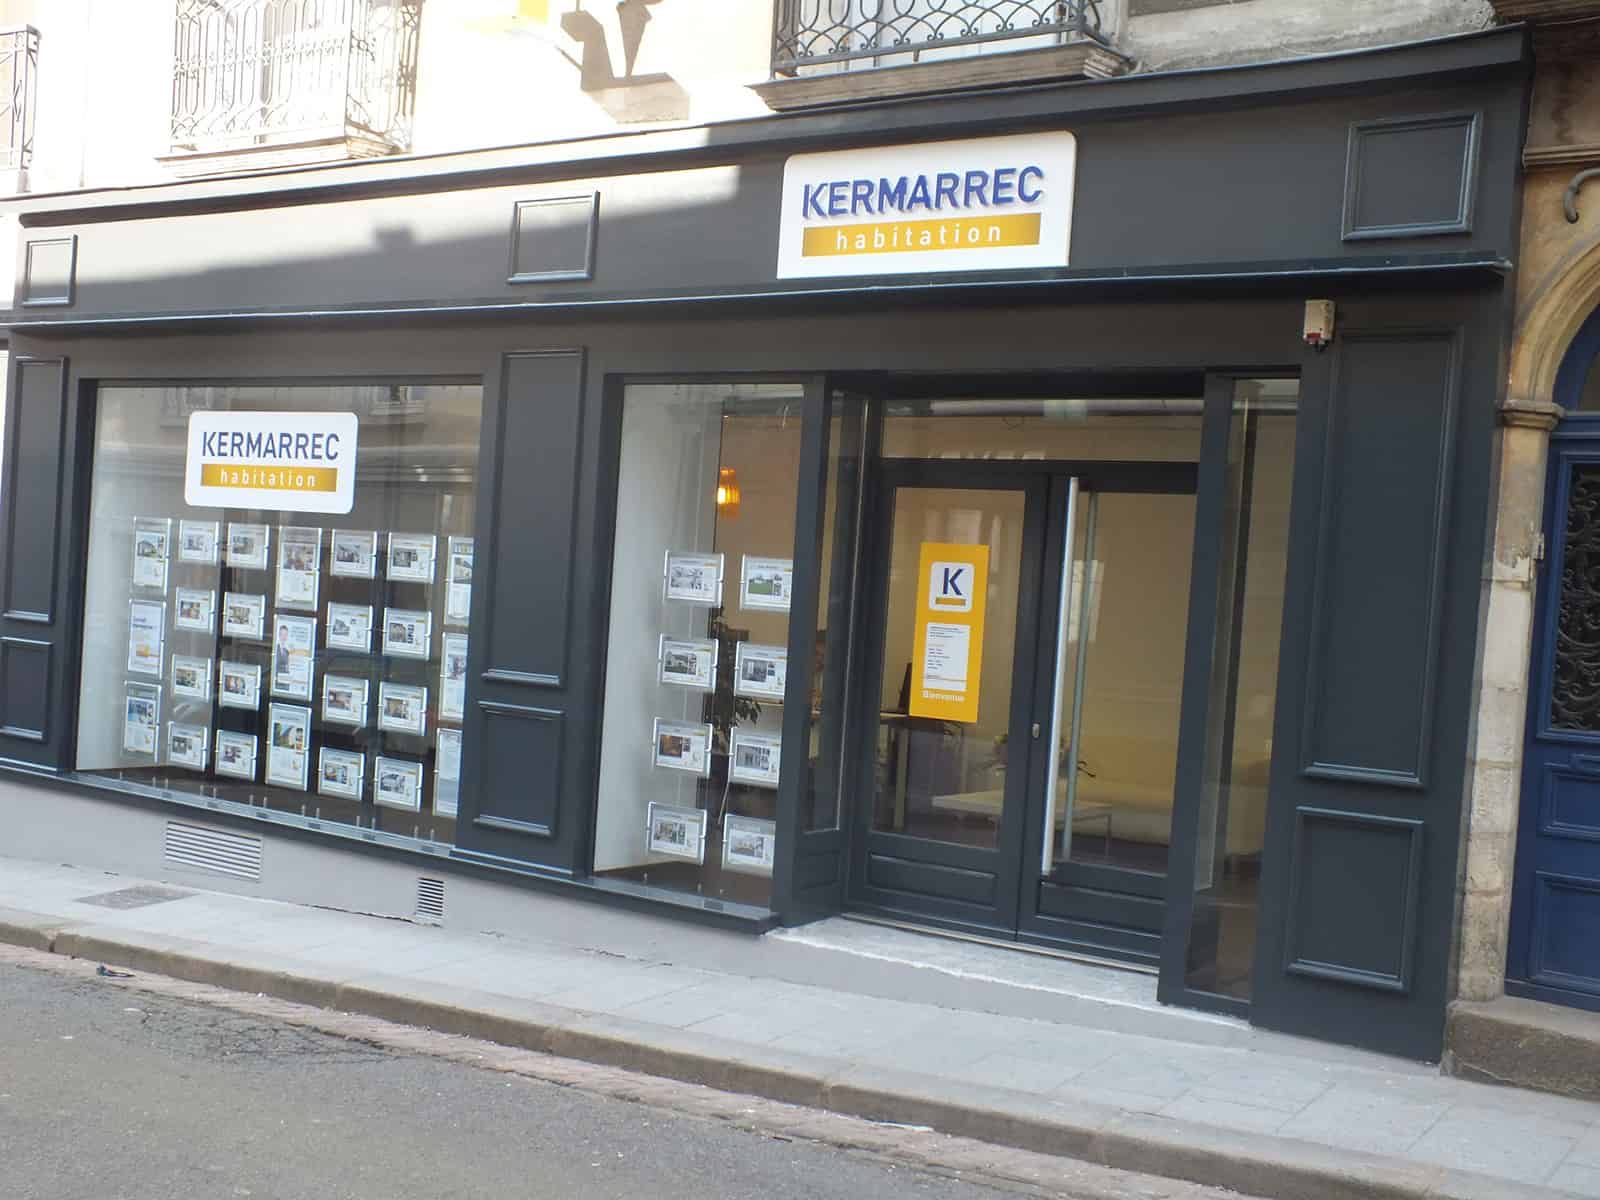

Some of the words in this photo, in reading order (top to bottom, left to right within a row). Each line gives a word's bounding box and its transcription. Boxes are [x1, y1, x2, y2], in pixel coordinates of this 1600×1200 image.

[802, 165, 1044, 218] KERMARREC
[836, 223, 1001, 250] habitation
[202, 431, 340, 460] KERMARREC
[220, 468, 316, 488] habitation
[943, 567, 964, 595] K
